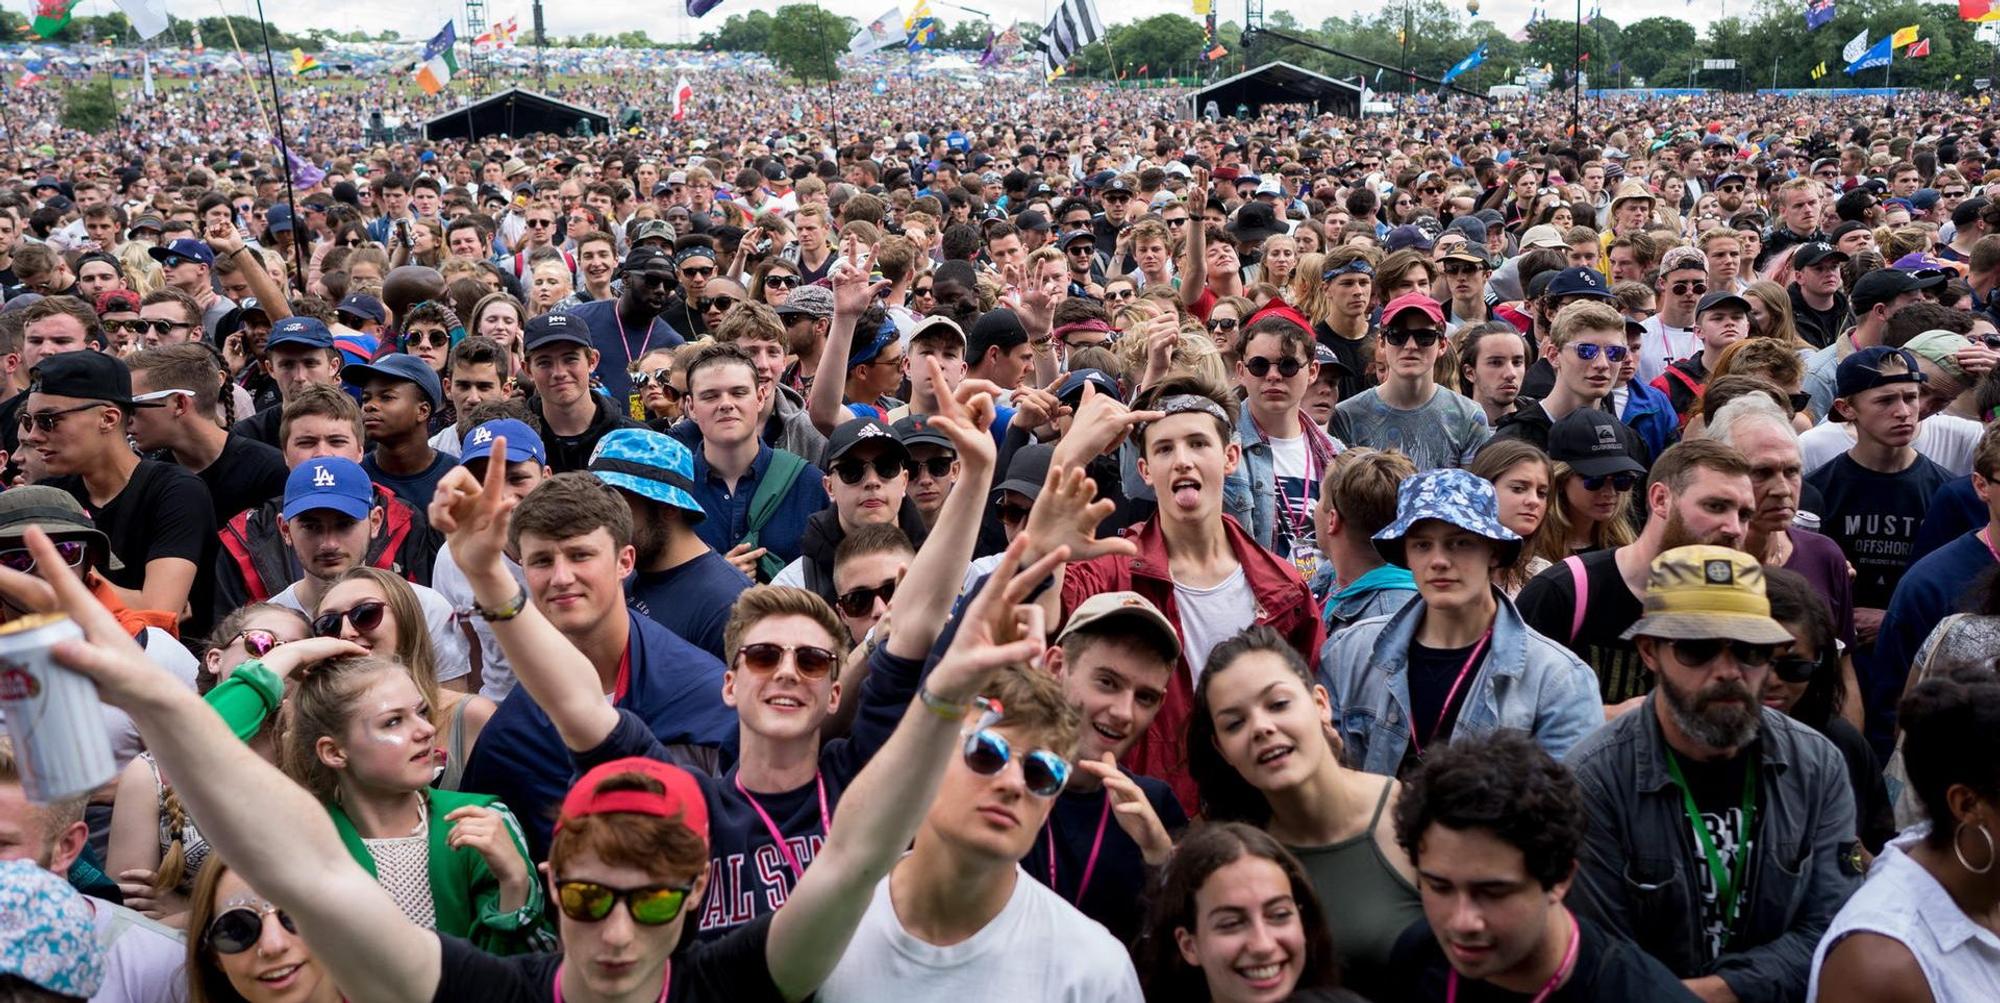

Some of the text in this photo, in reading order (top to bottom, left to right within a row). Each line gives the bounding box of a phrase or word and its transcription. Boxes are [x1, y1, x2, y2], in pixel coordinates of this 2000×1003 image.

[472, 426, 493, 446] LA
[312, 464, 336, 487] LA
[1844, 514, 1925, 537] MUST
[754, 834, 828, 911] ST
